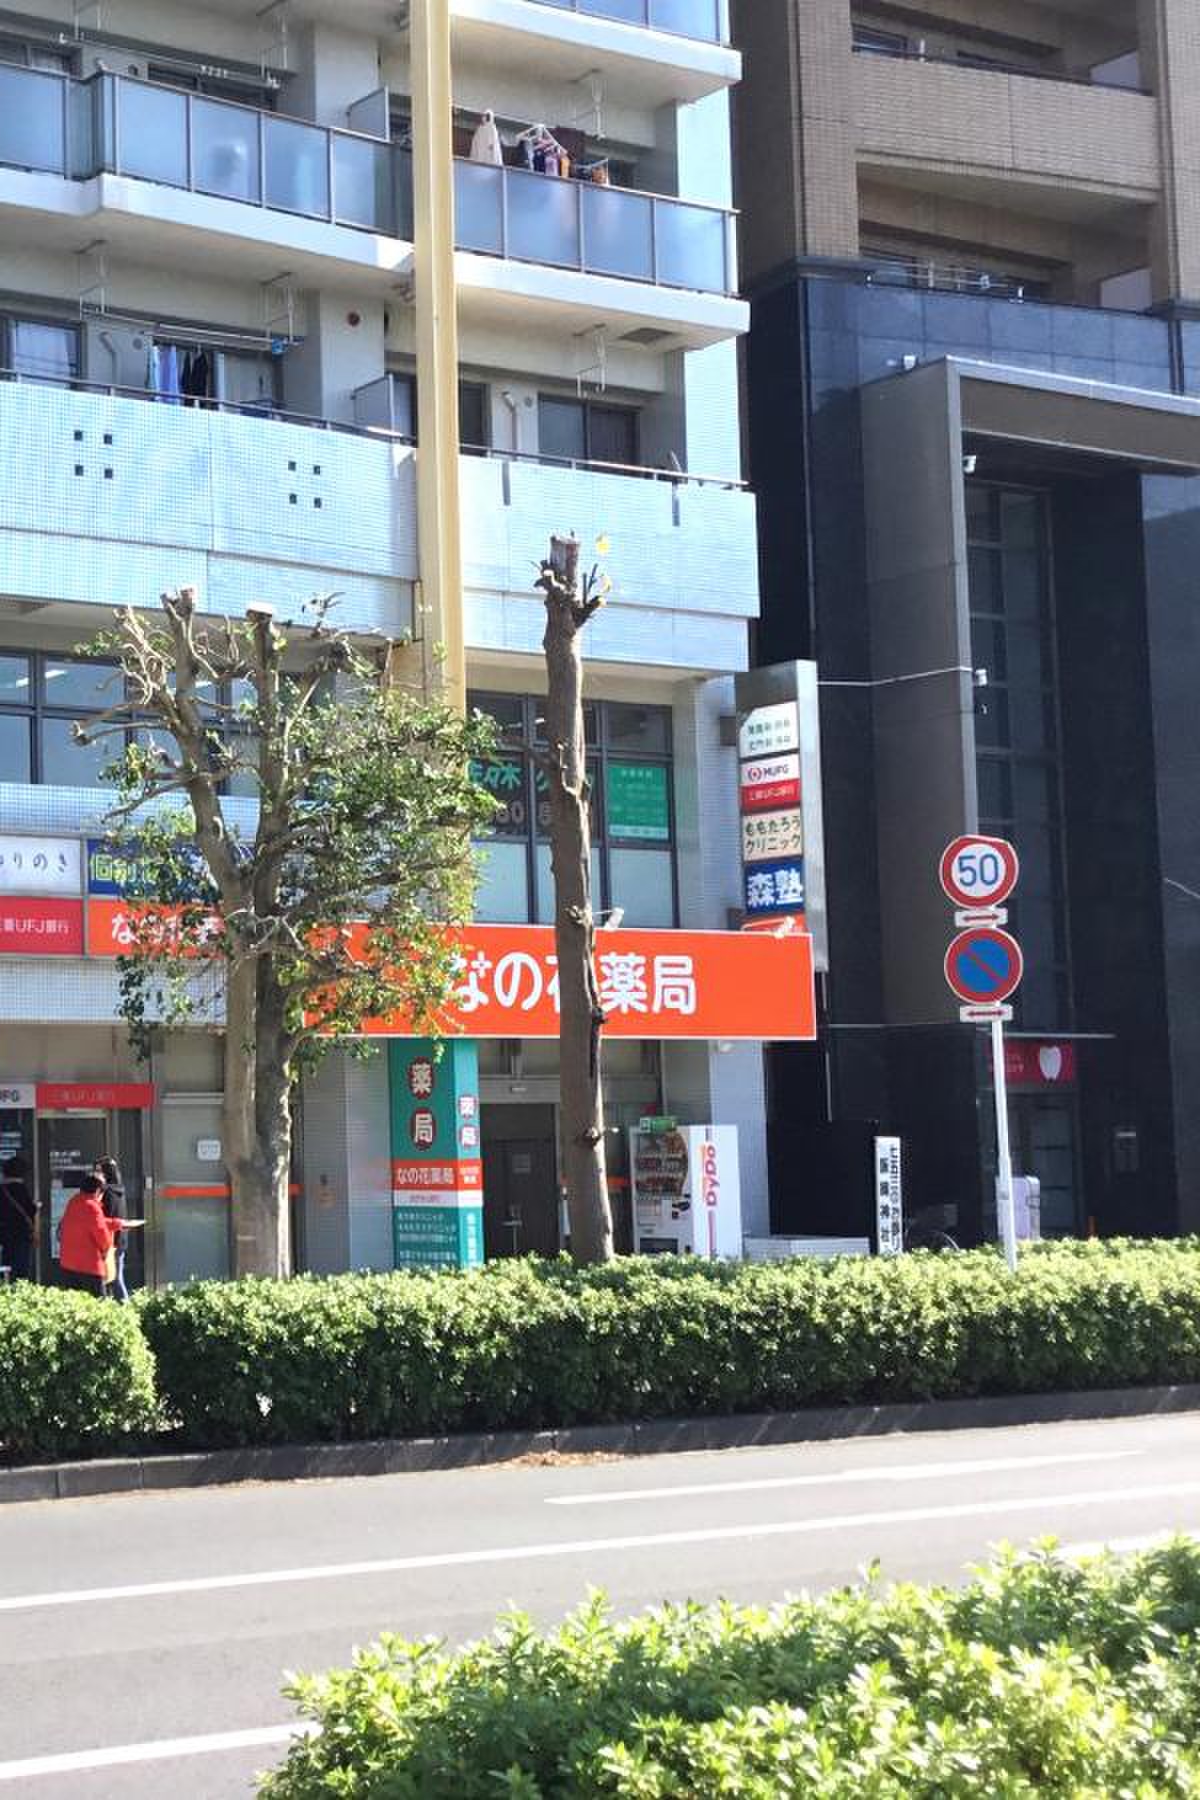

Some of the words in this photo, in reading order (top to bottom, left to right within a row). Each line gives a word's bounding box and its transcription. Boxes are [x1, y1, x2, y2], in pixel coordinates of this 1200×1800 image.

[745, 816, 800, 836] ももたろう
[745, 834, 801, 854] クリニック
[747, 867, 804, 908] 森塾
[958, 854, 1000, 888] 50
[445, 950, 697, 1015] なの薬局
[411, 1060, 435, 1145] 薬局
